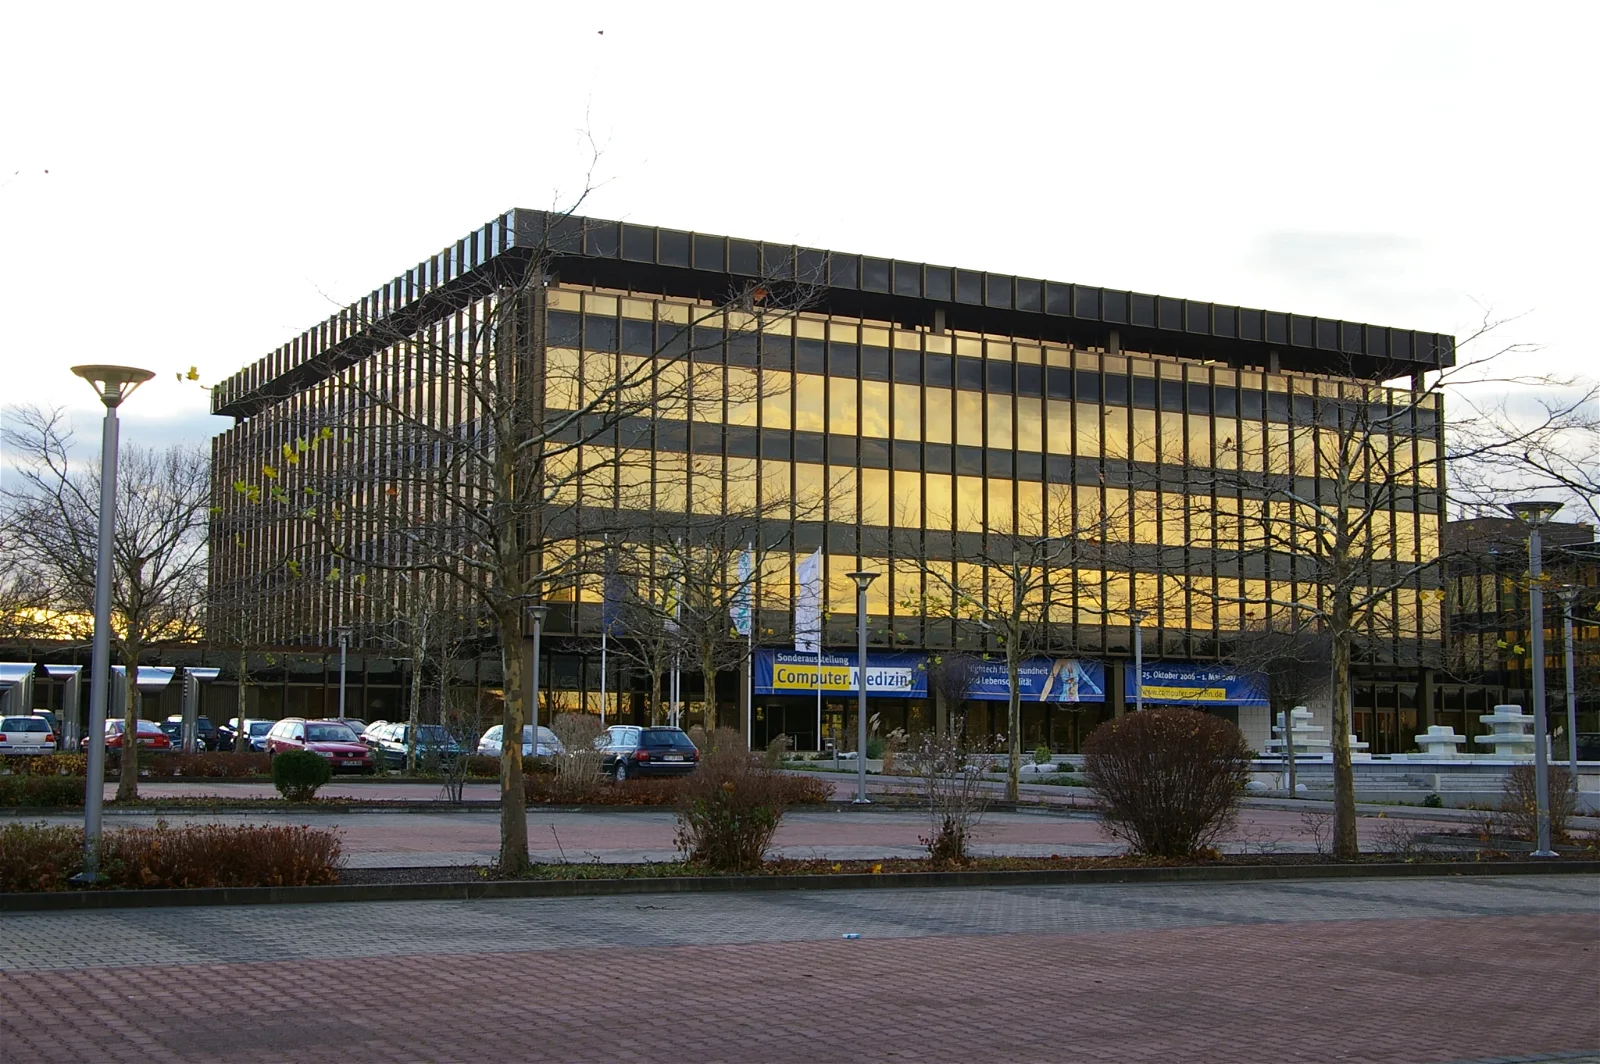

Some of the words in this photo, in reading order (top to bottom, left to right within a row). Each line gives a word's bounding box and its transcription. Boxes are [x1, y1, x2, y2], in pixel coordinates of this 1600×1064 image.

[1016, 666, 1048, 675] esundheit
[1142, 671, 1152, 680] 25.
[1153, 671, 1179, 680] Oktober
[1180, 672, 1196, 680] 2006
[777, 668, 908, 688] Computer.Medizin
[981, 676, 1032, 687] Lebensqlität
